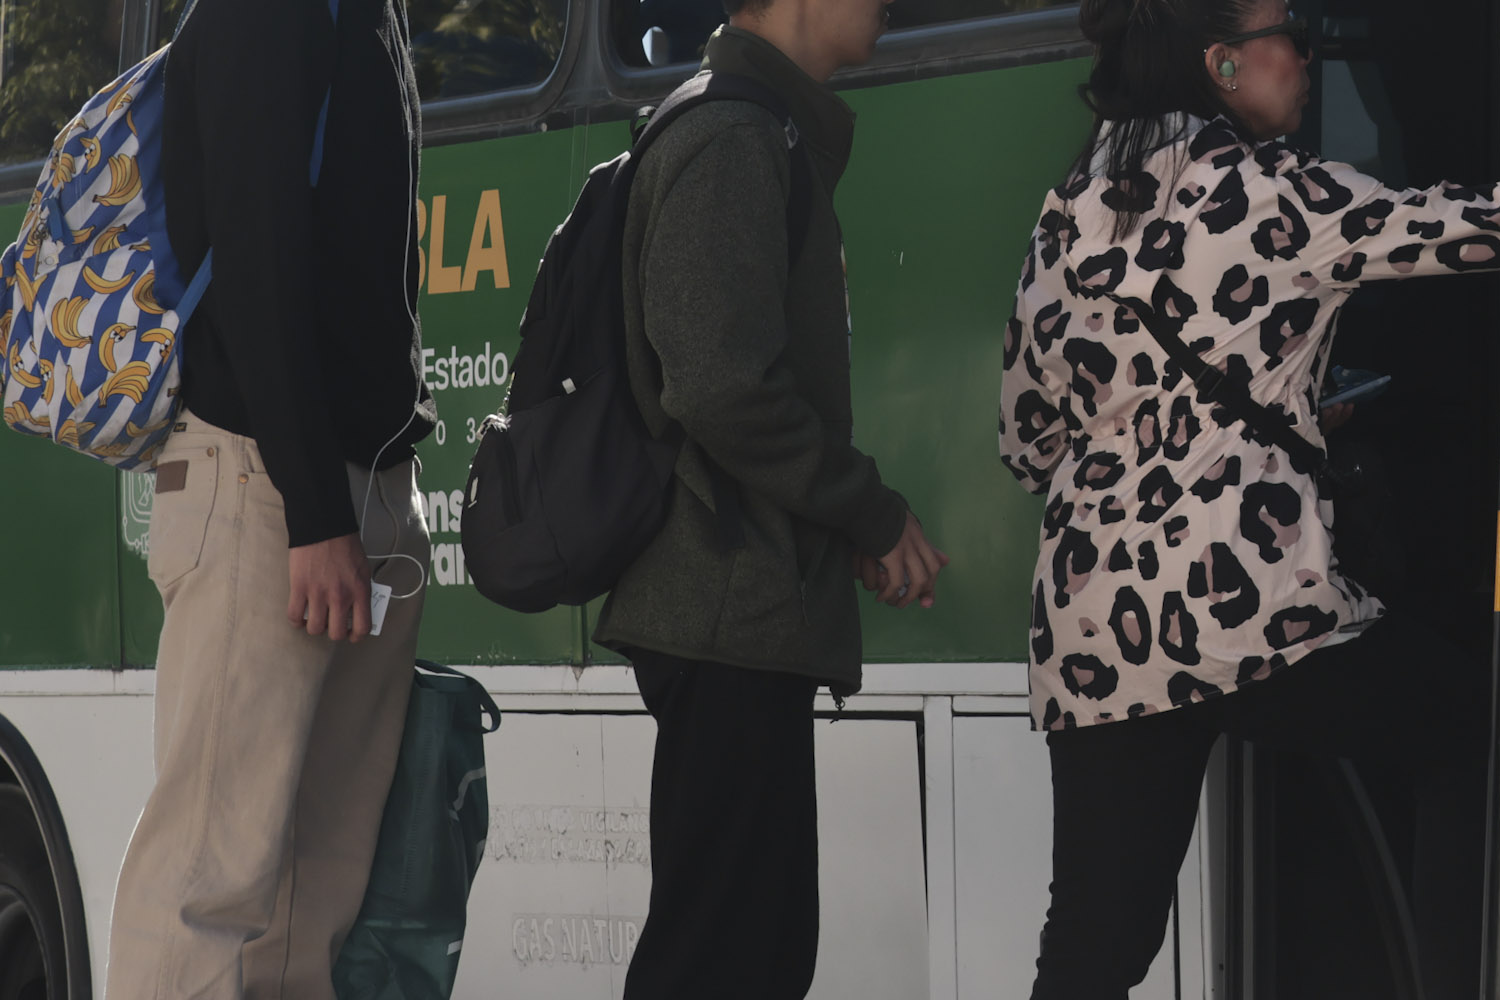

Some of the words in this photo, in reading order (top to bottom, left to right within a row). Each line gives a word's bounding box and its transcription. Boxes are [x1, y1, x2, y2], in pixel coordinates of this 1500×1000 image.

[417, 188, 511, 295] LA
[421, 341, 509, 391] Estado
[512, 917, 556, 962] GAS
